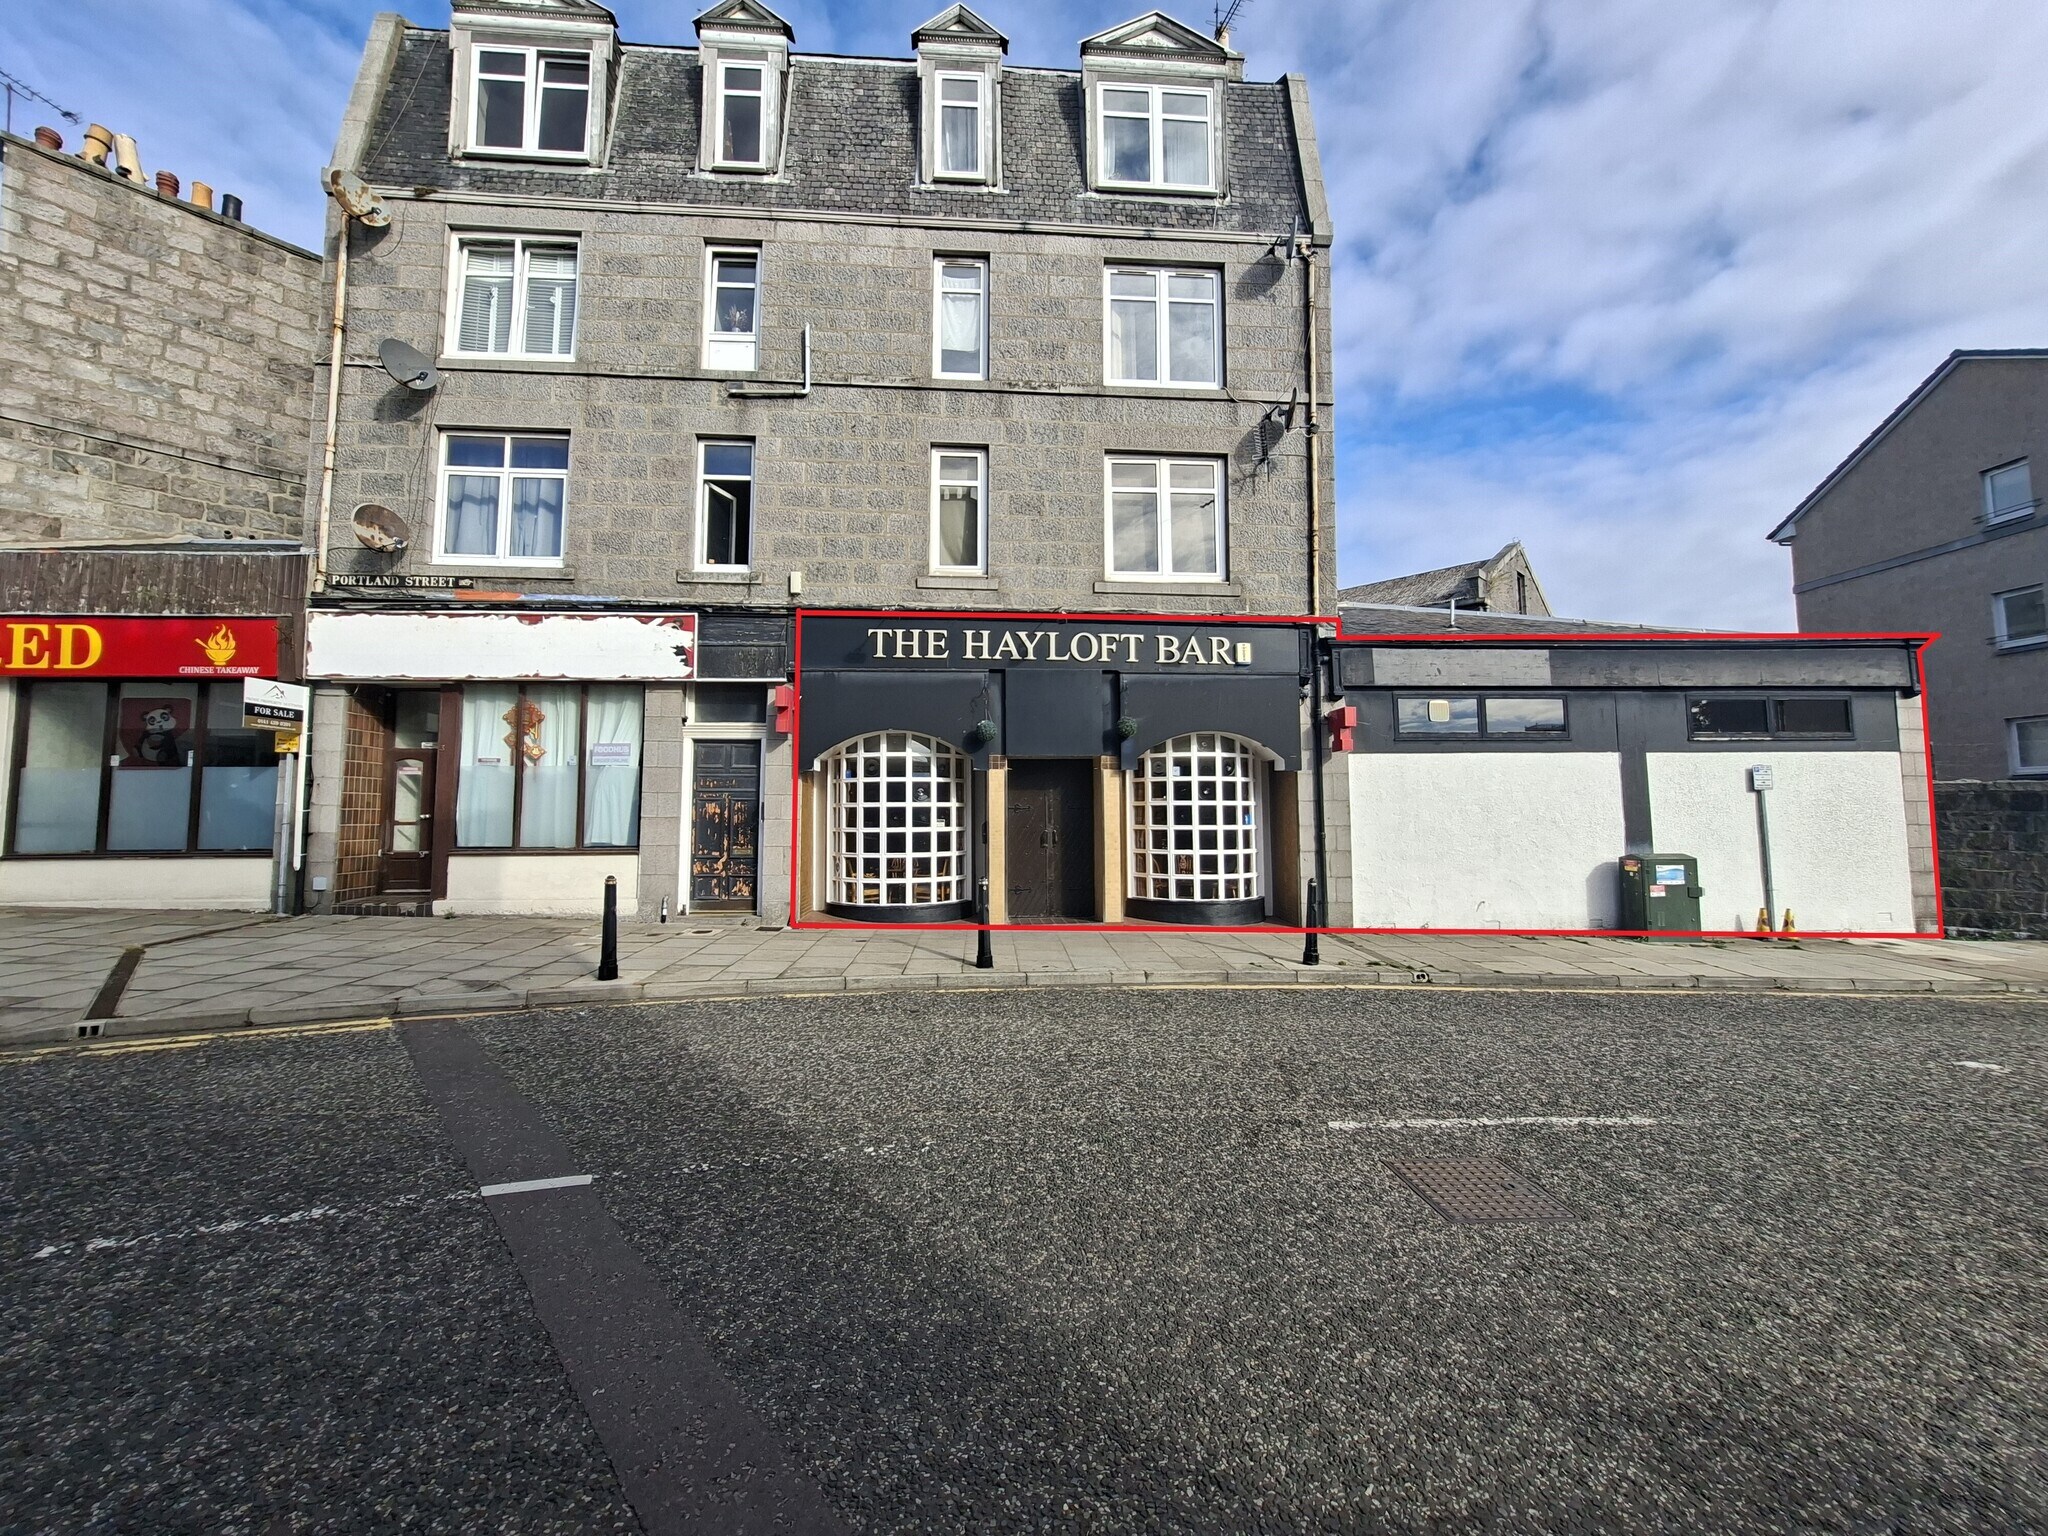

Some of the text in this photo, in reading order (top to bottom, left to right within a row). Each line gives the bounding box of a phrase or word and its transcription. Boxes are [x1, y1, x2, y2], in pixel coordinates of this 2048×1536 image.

[332, 575, 455, 587] PORTLAND STREET
[0, 623, 103, 669] ED
[867, 629, 949, 659] THE
[962, 630, 1144, 662] HAYLOFT
[1155, 635, 1236, 665] BAR
[179, 666, 260, 674] CHINESE TAKEAWAY
[254, 706, 295, 718] FOR SALE
